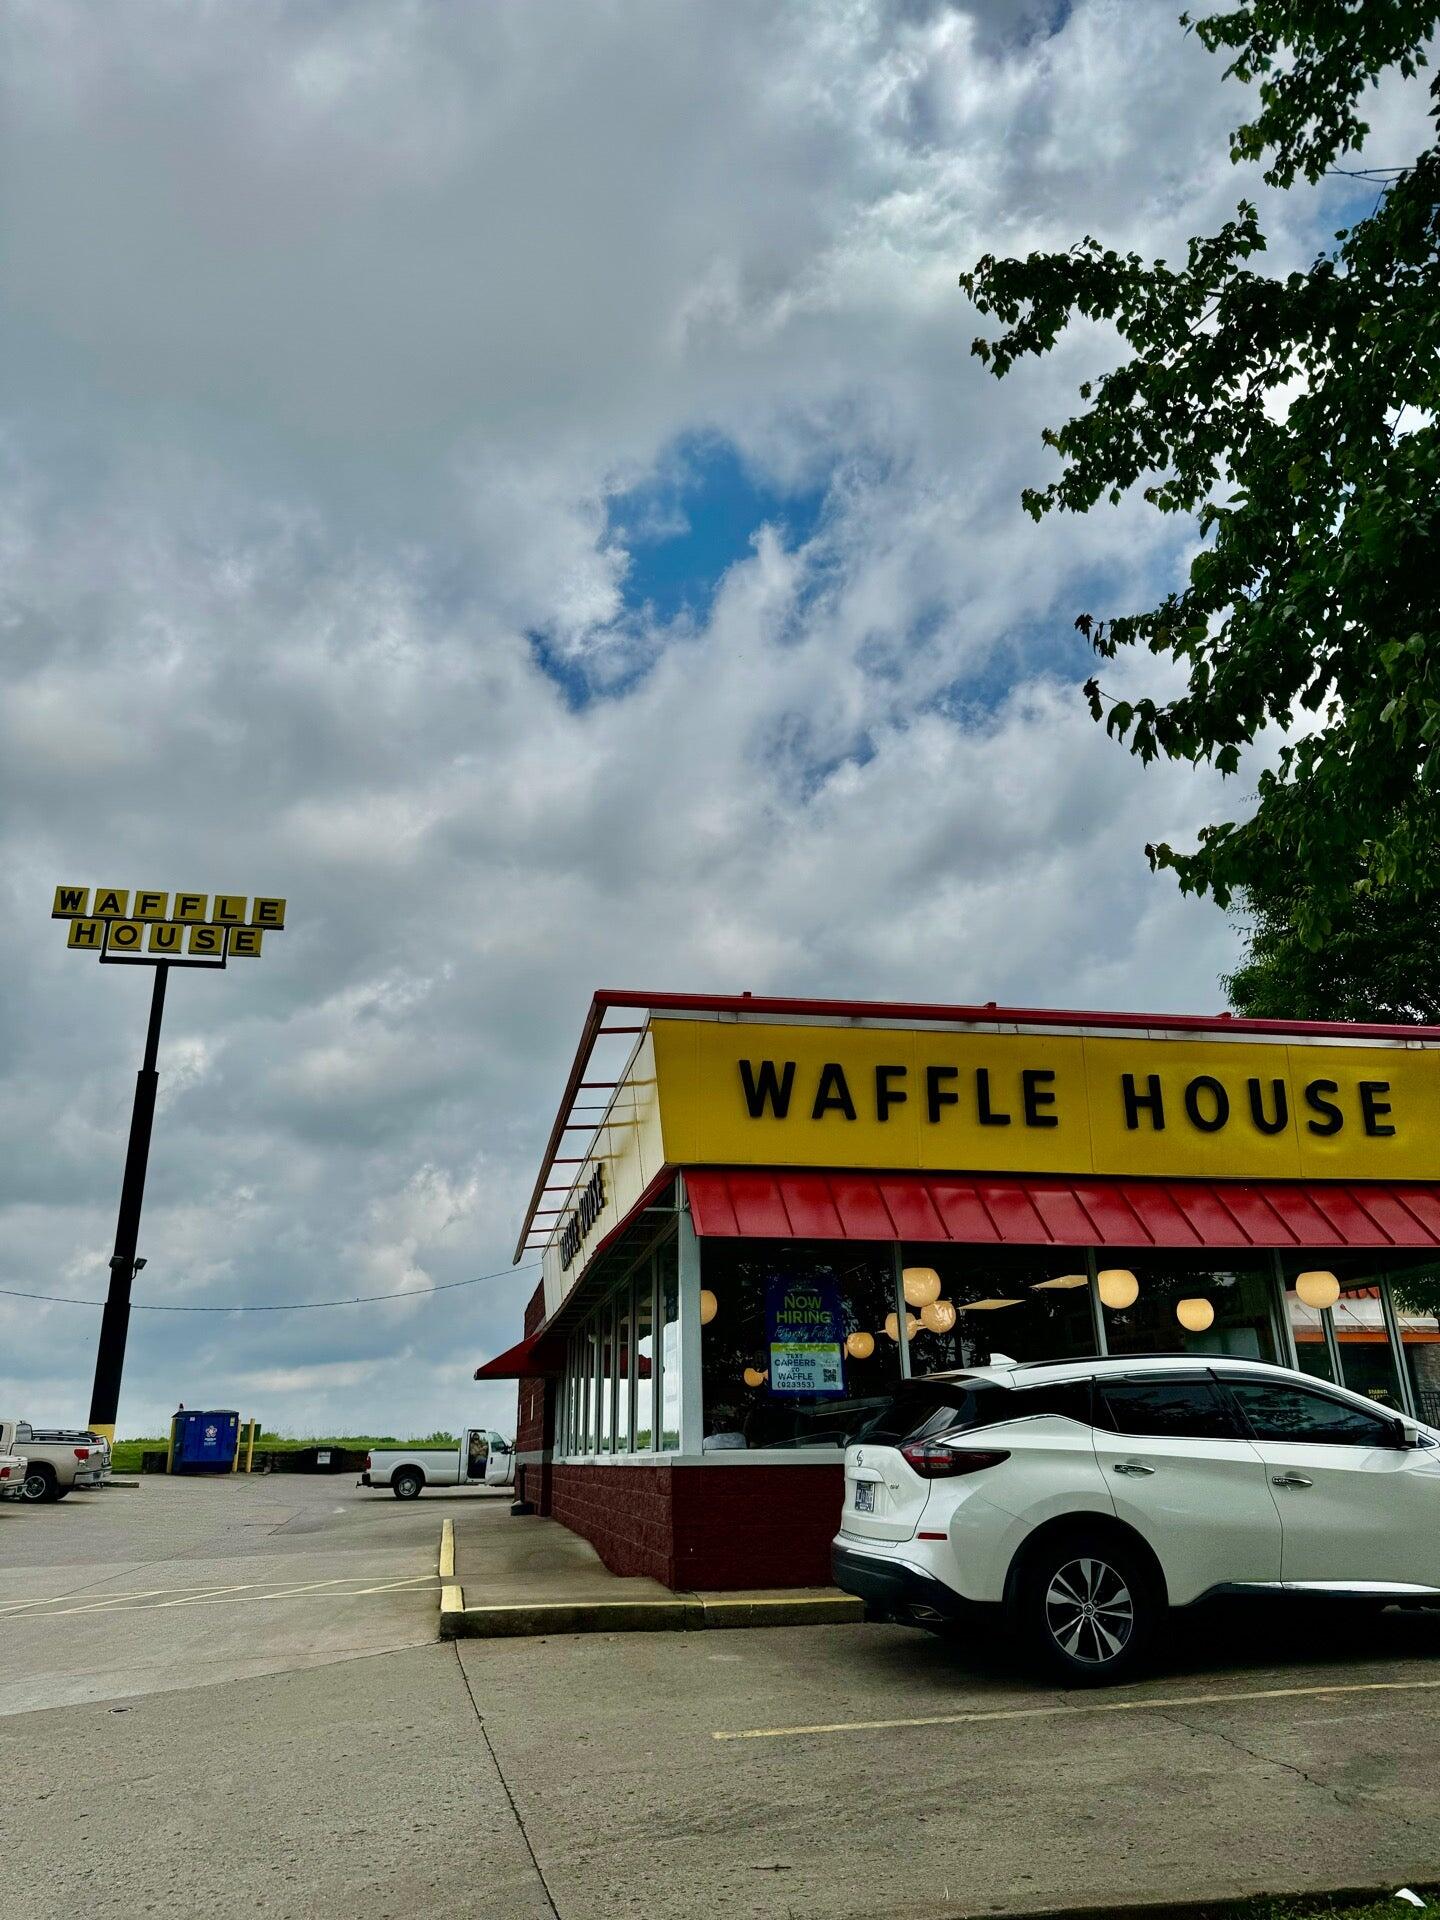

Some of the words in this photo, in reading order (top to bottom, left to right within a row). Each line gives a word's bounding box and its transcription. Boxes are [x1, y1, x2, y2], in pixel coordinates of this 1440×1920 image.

[60, 890, 279, 921] WAFFLE
[75, 923, 256, 951] HOUSE
[738, 1059, 1059, 1127] WAFFLE
[1121, 1073, 1396, 1136] HOUSE
[784, 1296, 822, 1309] NOW
[776, 1311, 832, 1324] HIRING
[774, 1359, 816, 1367] CAREERS
[778, 1373, 814, 1381] WAFFLE
